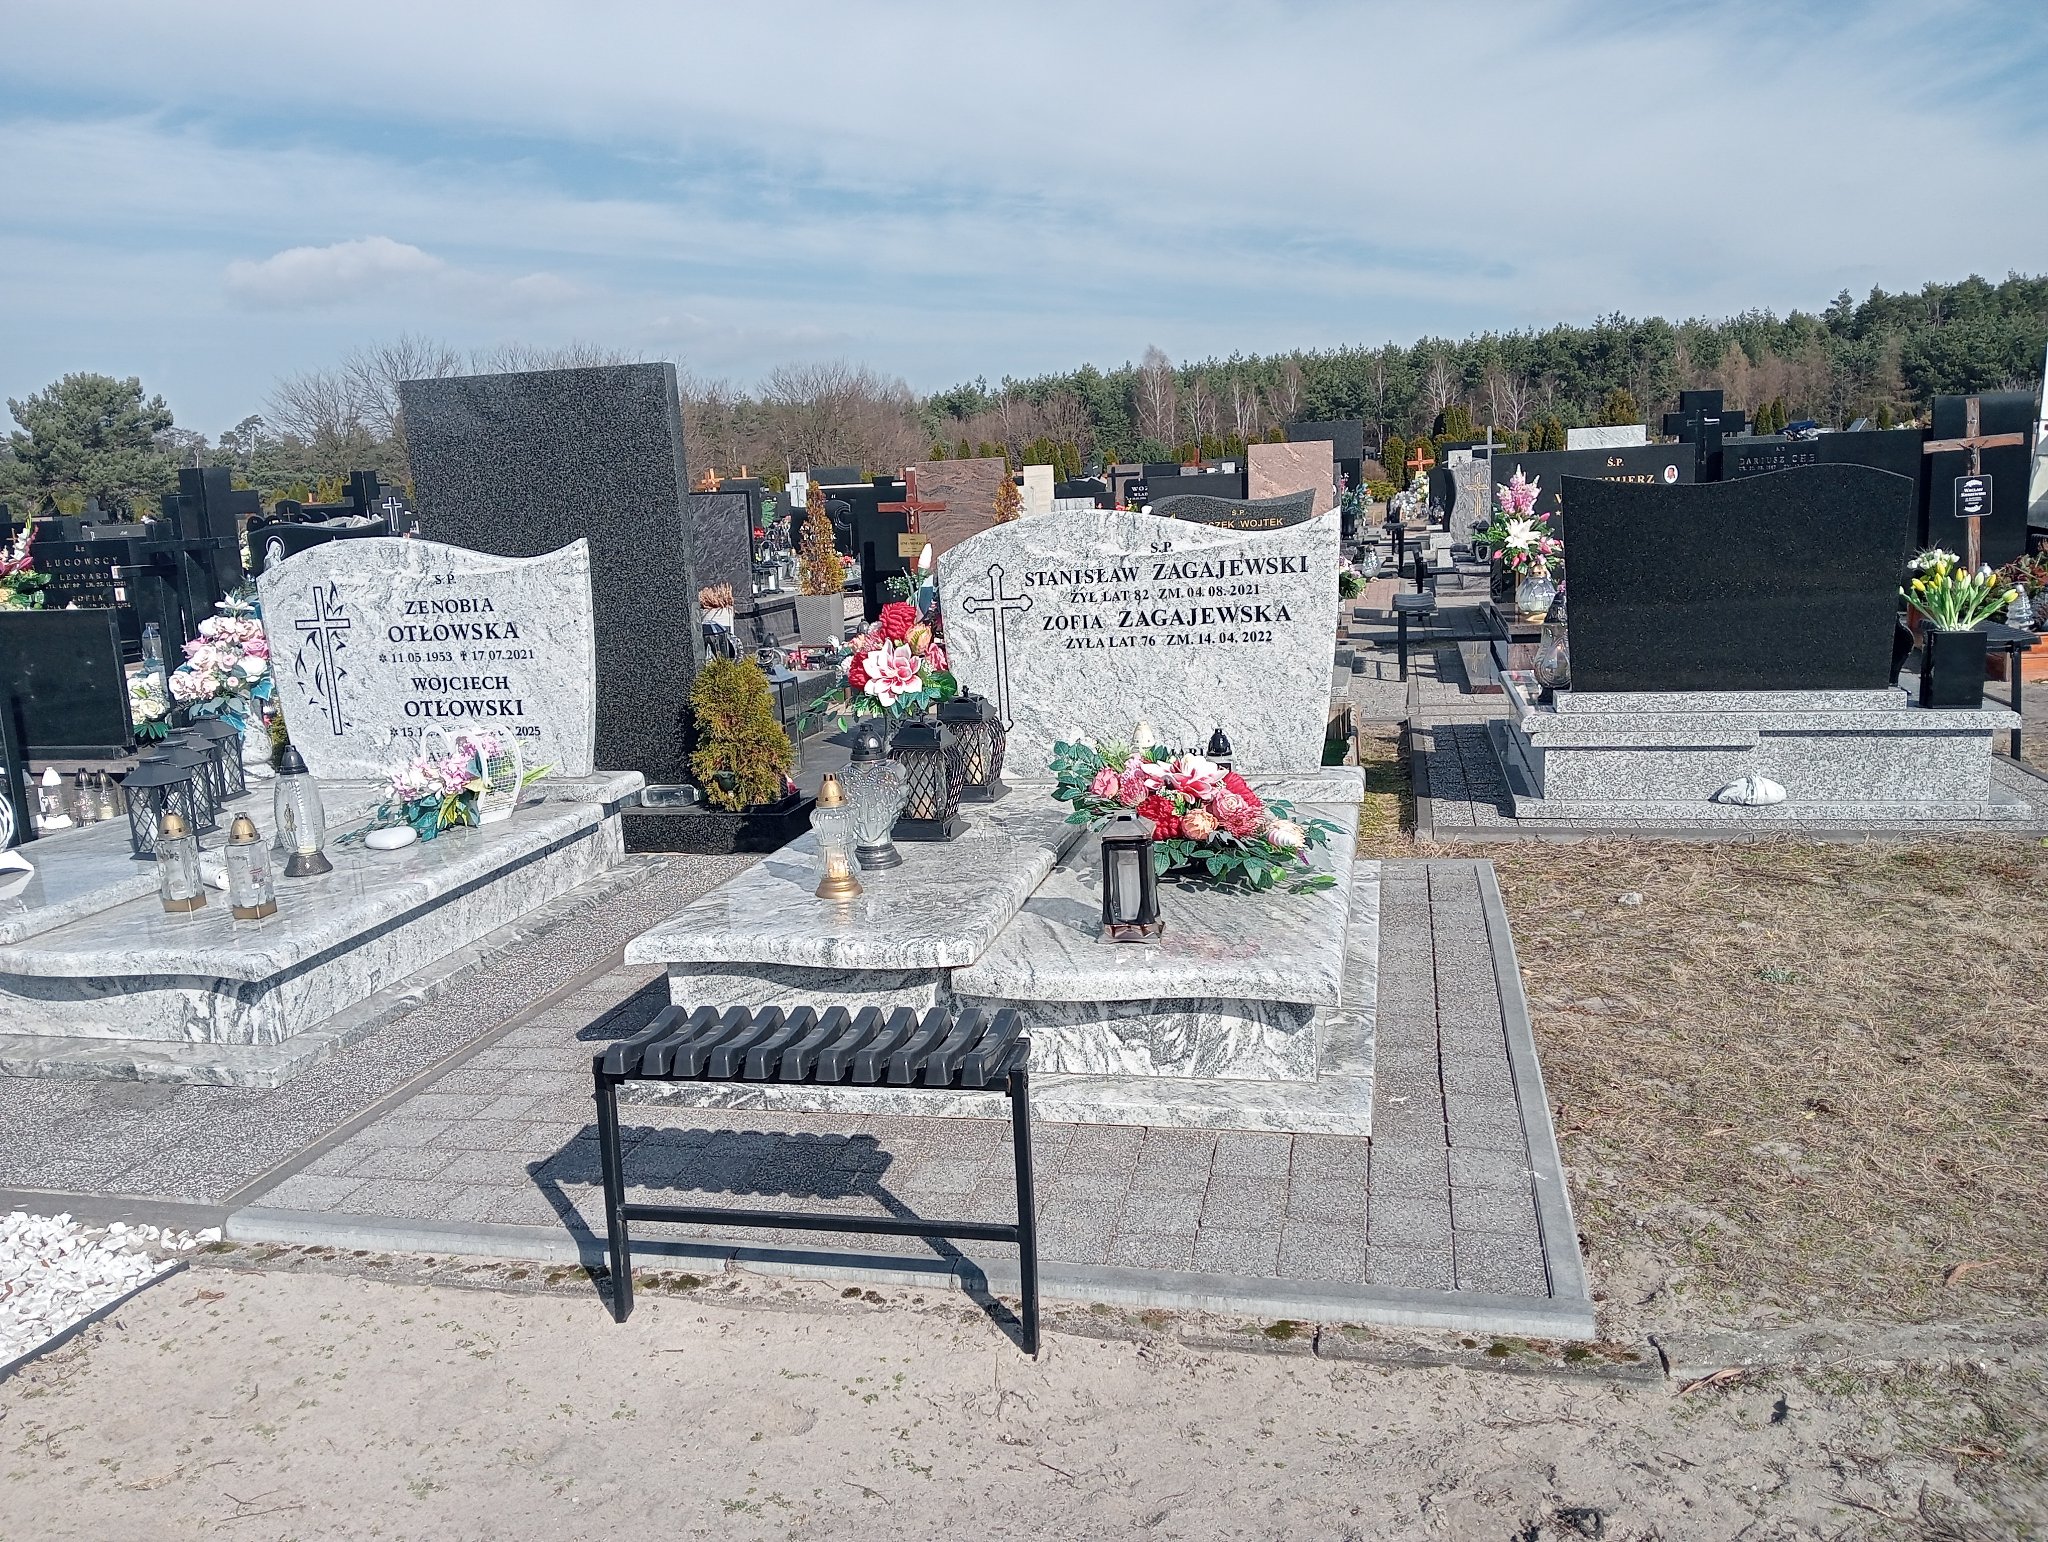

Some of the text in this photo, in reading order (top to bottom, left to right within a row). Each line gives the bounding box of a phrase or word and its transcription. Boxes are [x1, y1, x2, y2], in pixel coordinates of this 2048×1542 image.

[1240, 518, 1283, 528] WOJTEK
[1024, 555, 1309, 587] STANISŁAW ZAGAJEWSKI
[1102, 590, 1130, 602] LAT
[1134, 589, 1150, 601] 82
[1158, 587, 1184, 600] ZM.
[404, 598, 495, 615] ZENOBIA
[1042, 604, 1292, 631] ZOFIA ZAGAJEWSKA
[387, 622, 520, 643] OTŁOWSKA
[1108, 636, 1136, 648] LAT
[1141, 635, 1157, 647] 76
[1166, 634, 1194, 645] ZM.
[391, 649, 534, 664] 11.05.1953 17.07.2021
[410, 676, 510, 694] WOJCIECH
[404, 700, 525, 717] OTŁOWSKI
